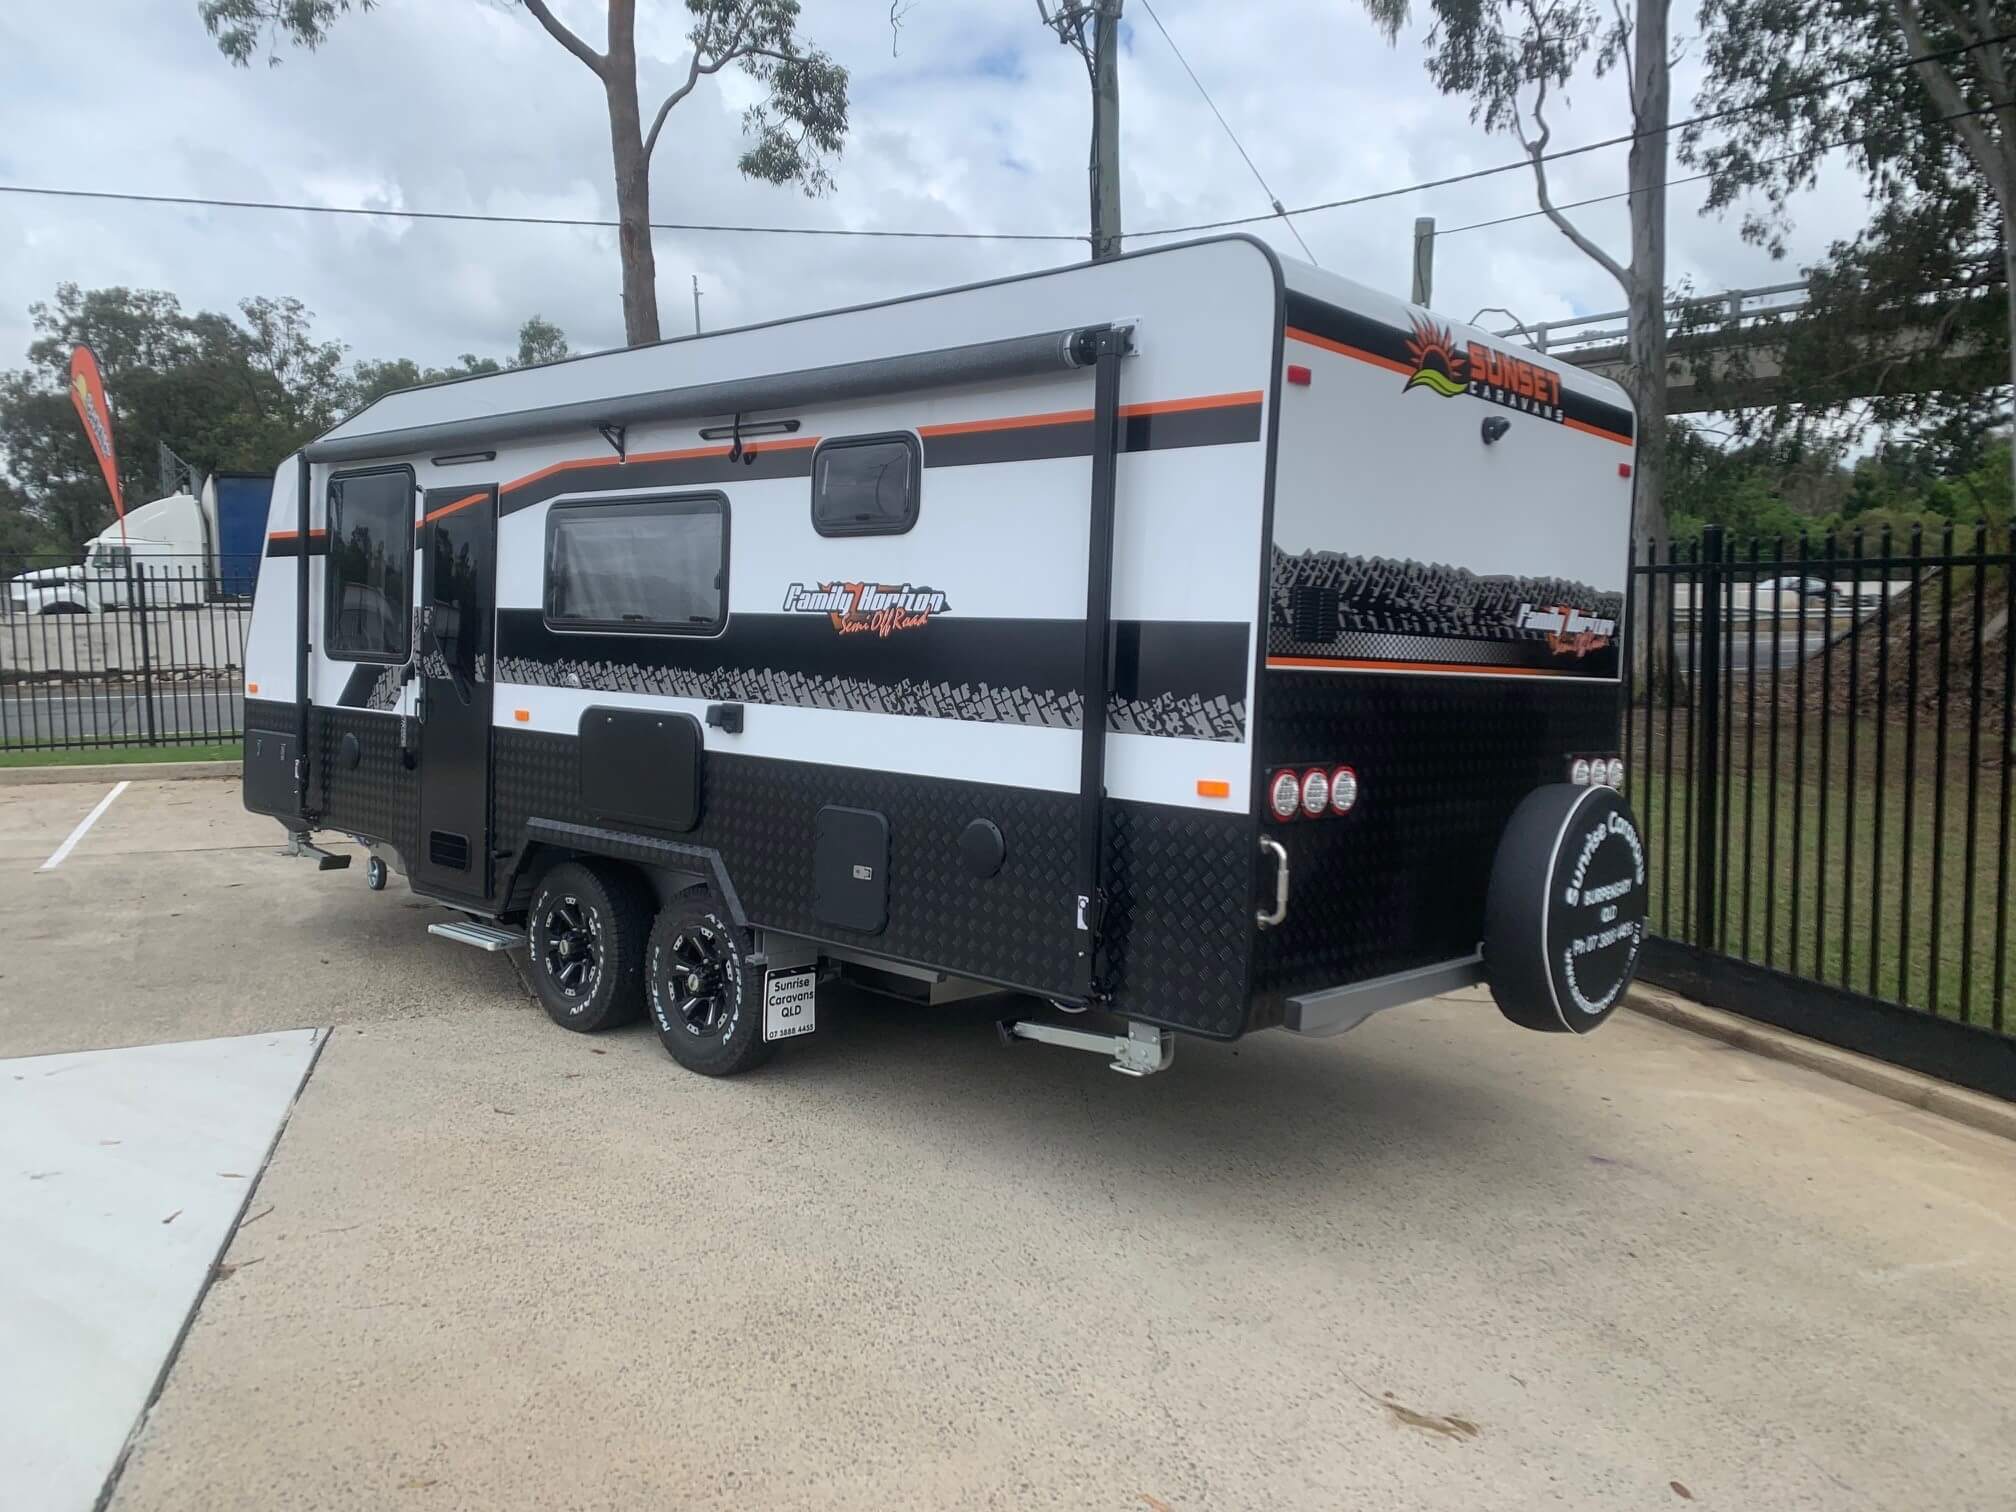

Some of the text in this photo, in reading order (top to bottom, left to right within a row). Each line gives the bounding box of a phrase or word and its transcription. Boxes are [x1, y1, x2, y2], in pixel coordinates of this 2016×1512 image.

[1468, 340, 1562, 405] SUNSET
[1469, 380, 1565, 422] CARAVANS
[784, 582, 945, 615] Family Horizon
[839, 607, 932, 637] Semi Off Road
[774, 977, 810, 992] Sunrise
[769, 991, 814, 1006] Caravans
[781, 1005, 802, 1018] QLD
[769, 1030, 778, 1039] 07
